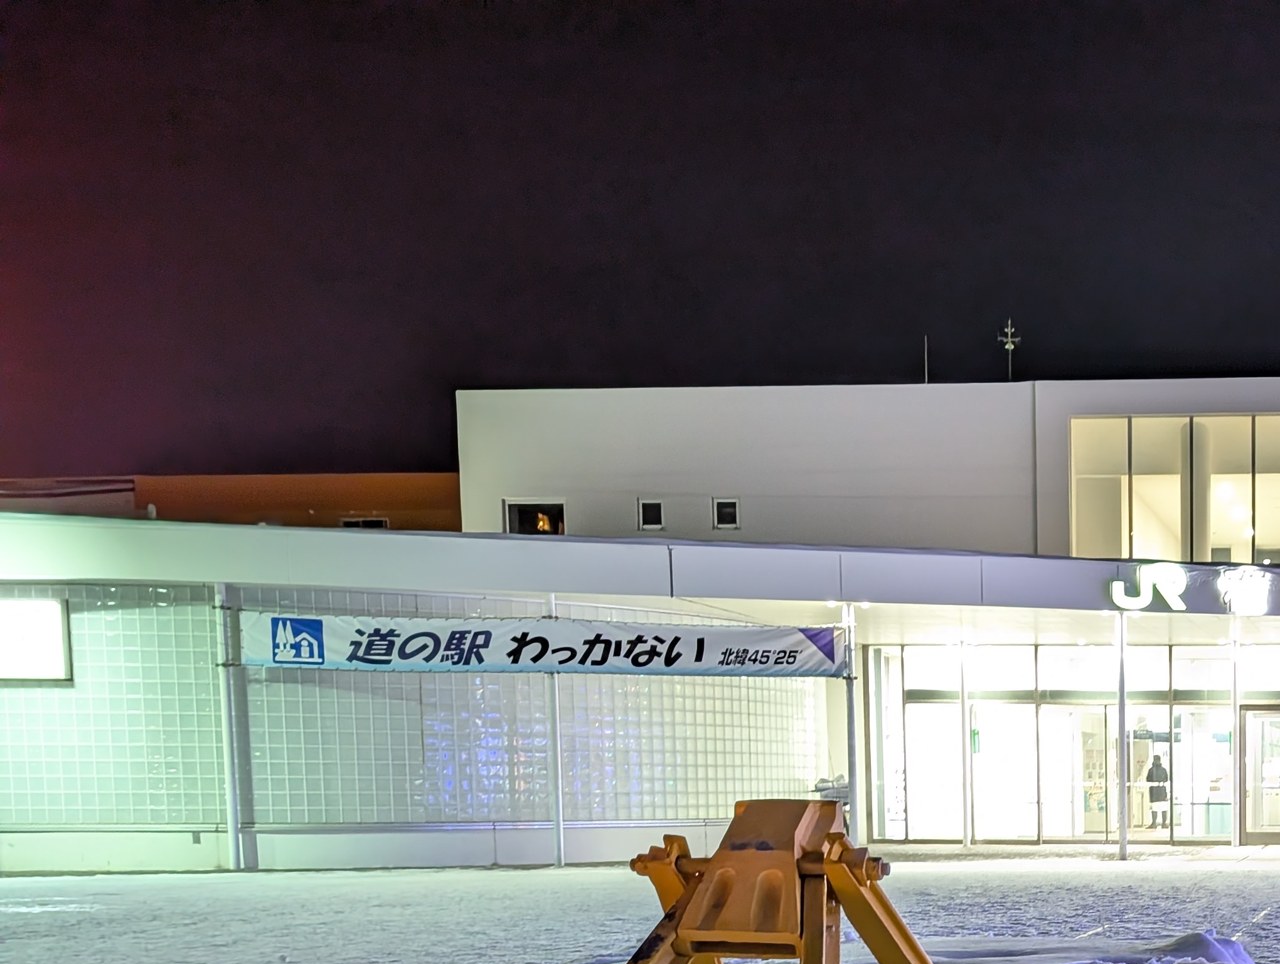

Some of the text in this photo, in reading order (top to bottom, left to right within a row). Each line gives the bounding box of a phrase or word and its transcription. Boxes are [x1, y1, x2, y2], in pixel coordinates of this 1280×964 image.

[1111, 562, 1187, 611] JR
[345, 627, 493, 666] 道の駅
[506, 631, 706, 668] わっかない
